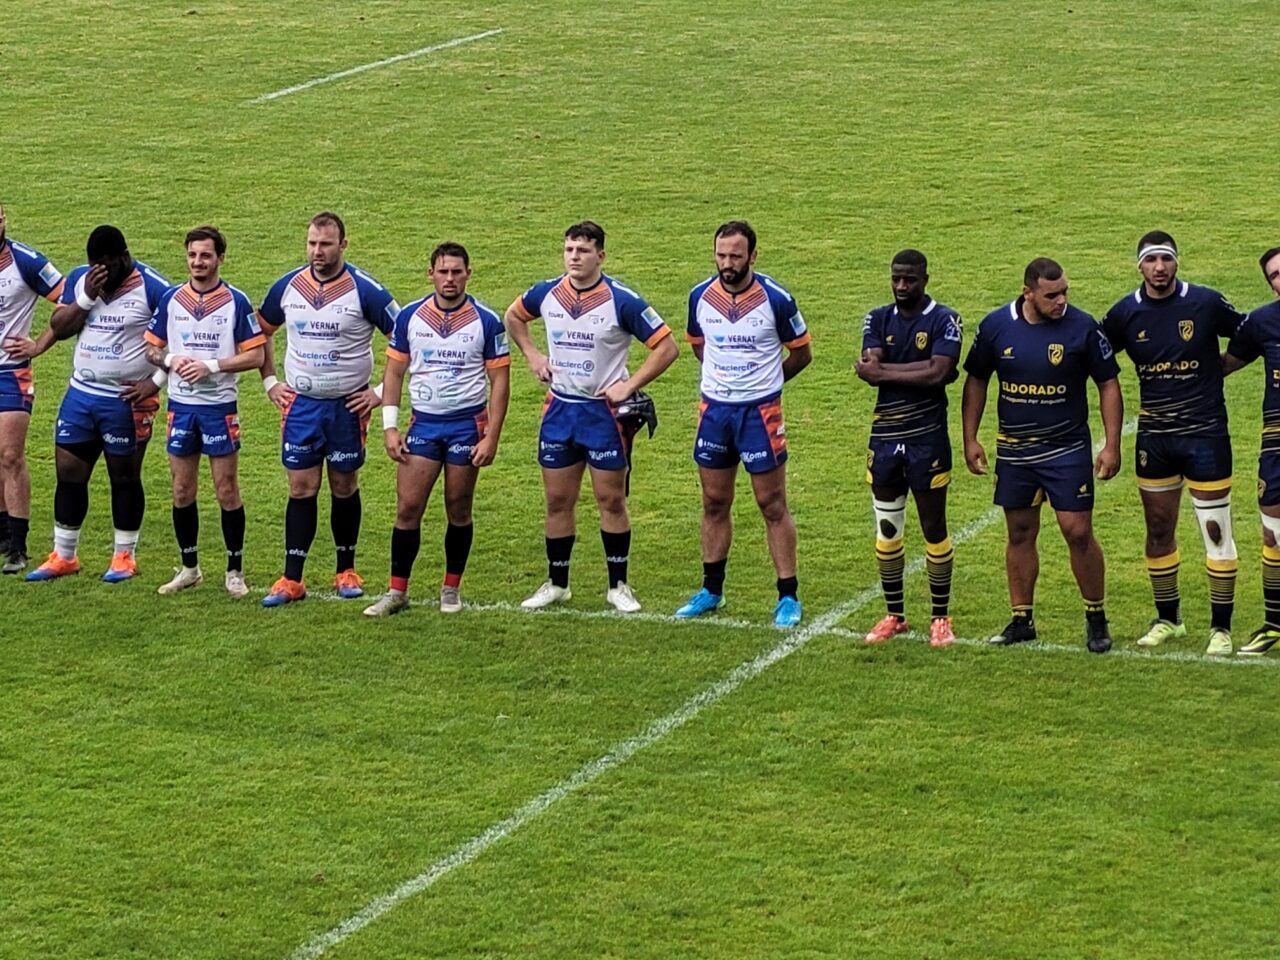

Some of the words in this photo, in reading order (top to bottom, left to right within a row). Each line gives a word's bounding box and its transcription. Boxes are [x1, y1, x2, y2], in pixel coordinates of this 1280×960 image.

[99, 315, 125, 324] VERNAT
[311, 321, 341, 331] VERNAT
[193, 332, 221, 341] VERNAT
[567, 331, 595, 341] VERNAT
[728, 335, 756, 344] VERNAT
[437, 349, 466, 360] VERNAT
[1002, 381, 1067, 395] ELDORADO
